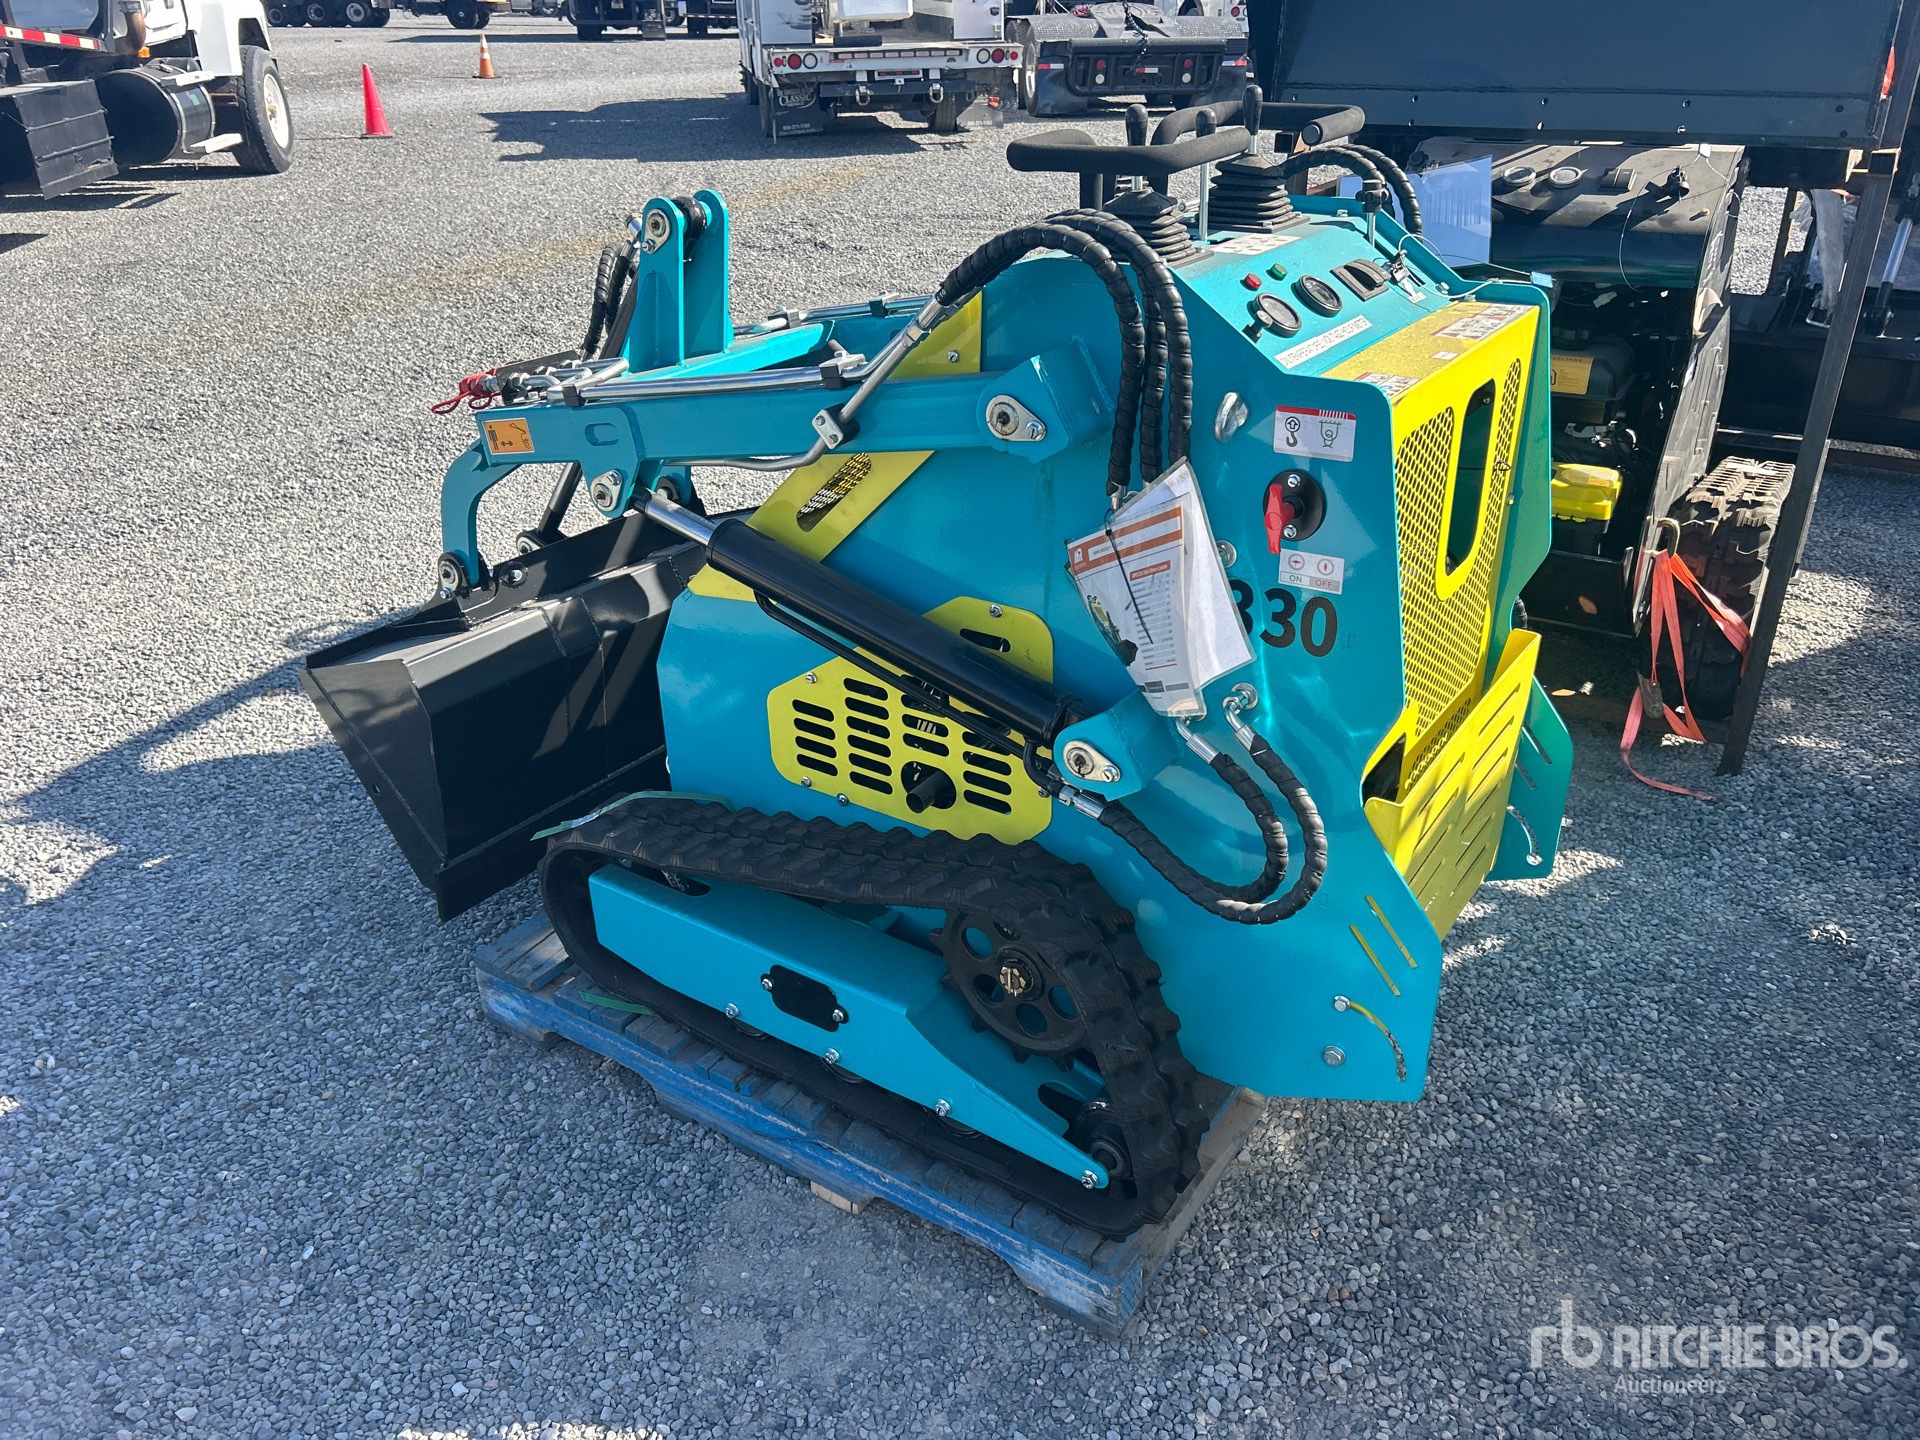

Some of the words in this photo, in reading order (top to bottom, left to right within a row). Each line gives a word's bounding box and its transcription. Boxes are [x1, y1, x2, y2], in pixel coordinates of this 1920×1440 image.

[779, 94, 812, 106] CLASSIC
[1289, 574, 1302, 583] ON
[1315, 579, 1333, 588] OFF
